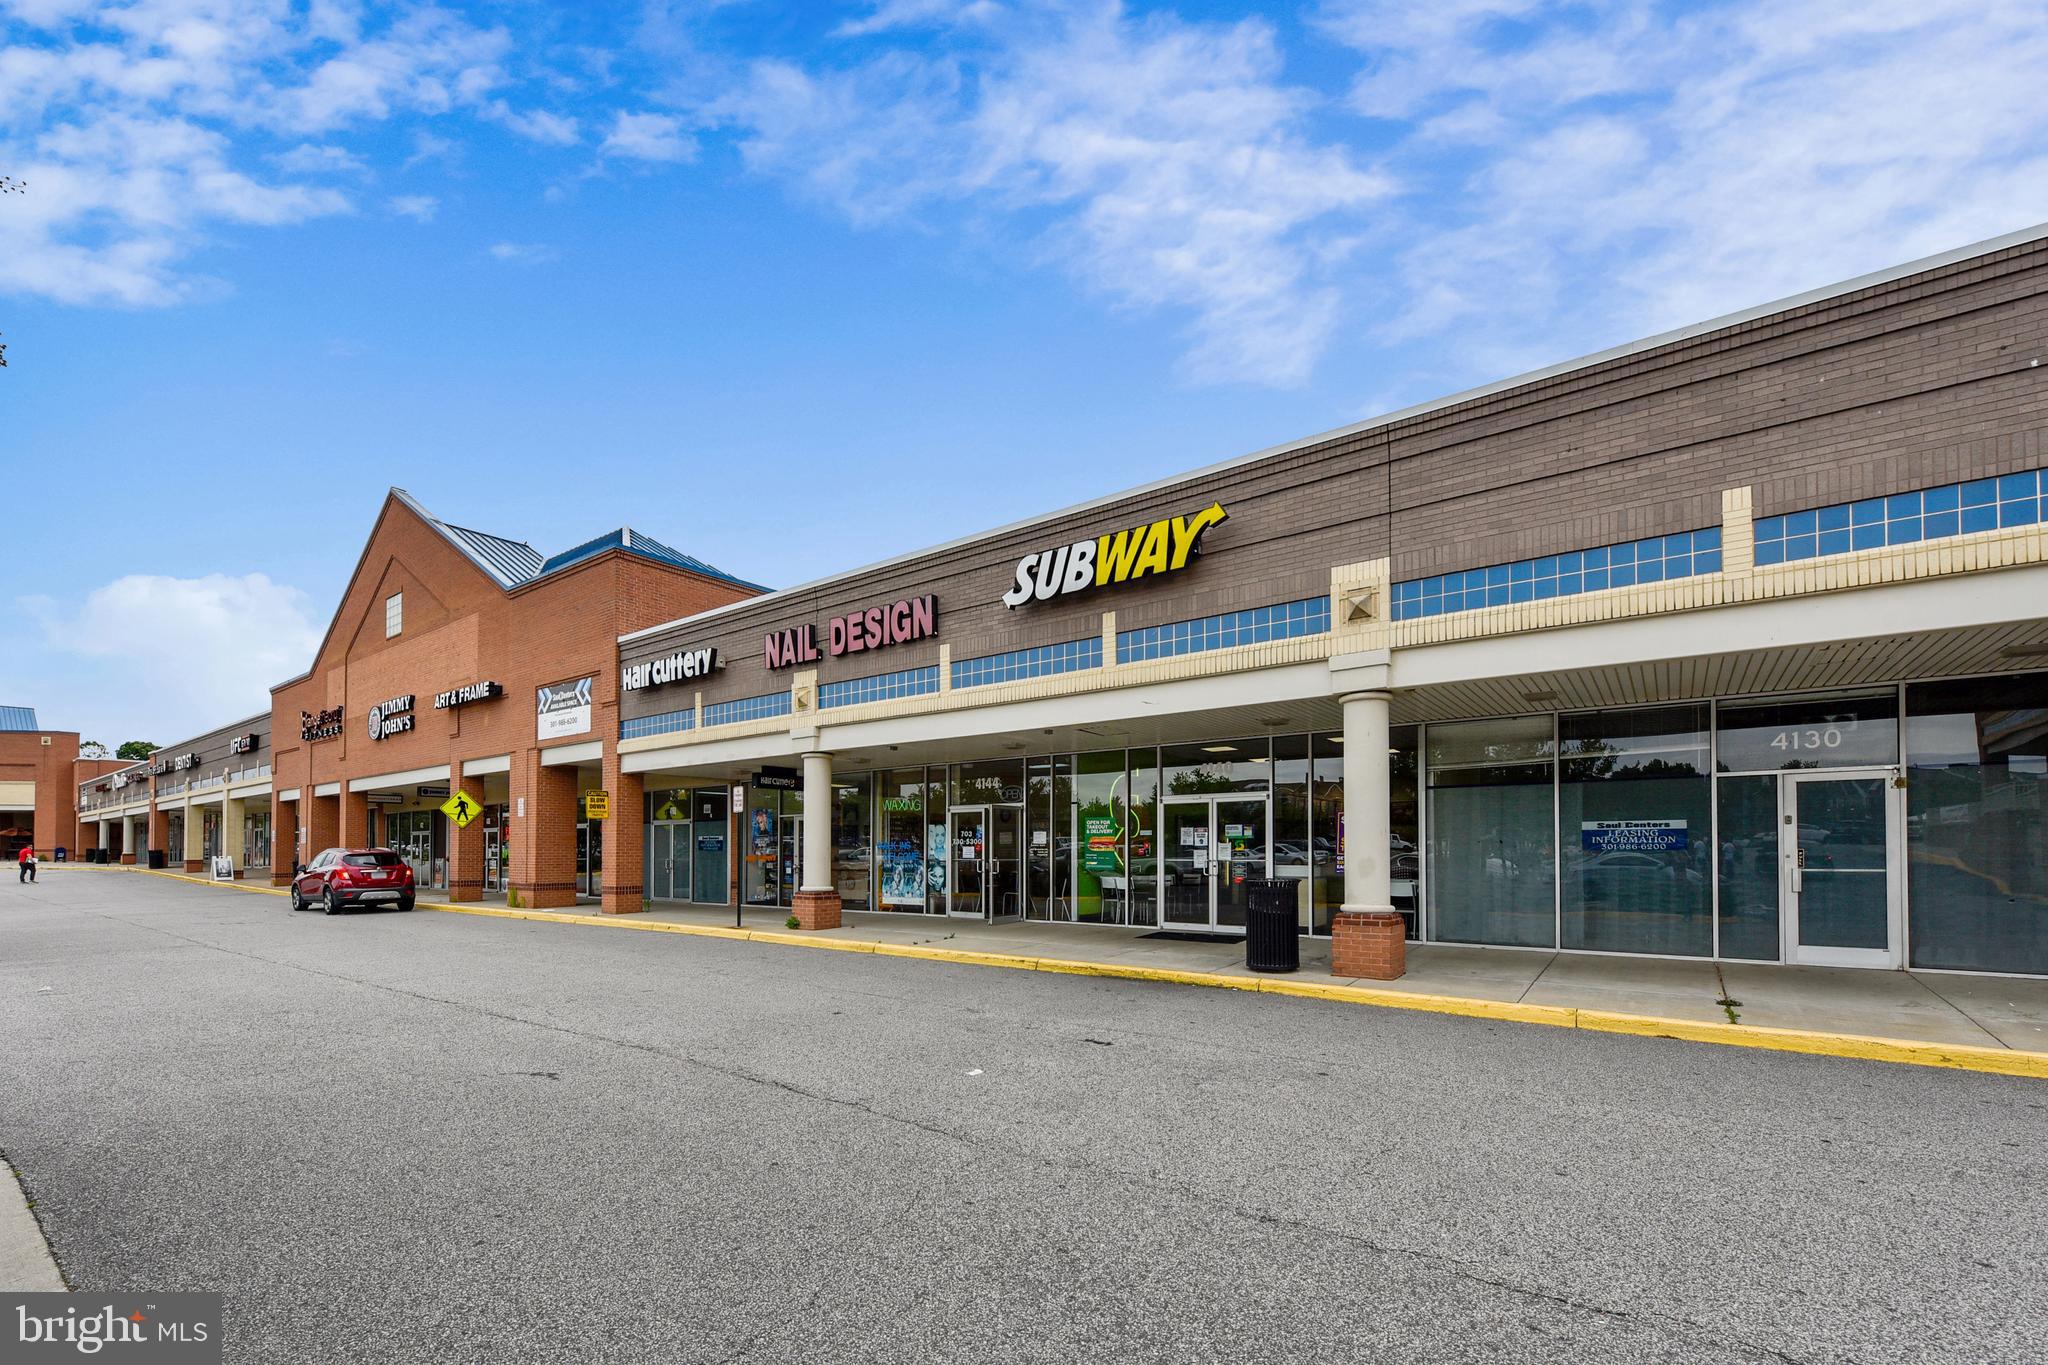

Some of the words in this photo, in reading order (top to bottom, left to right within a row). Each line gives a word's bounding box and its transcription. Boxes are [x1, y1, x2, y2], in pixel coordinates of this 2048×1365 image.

[1002, 501, 1228, 610] SUBWAY
[764, 623, 818, 670] NAIL
[829, 593, 934, 657] DESIGN
[622, 662, 651, 691] Hair
[433, 693, 450, 709] ART
[450, 692, 457, 705] &
[458, 681, 490, 703] FRAME
[381, 695, 411, 719] JIMMY
[381, 715, 411, 739] JOHN'S
[1770, 729, 1842, 750] 4130
[174, 753, 192, 771] DENTIST
[975, 777, 1001, 790] 4144
[883, 799, 921, 812] WAXING
[960, 830, 973, 838] 703
[1608, 829, 1659, 838] LEASING
[1625, 821, 1671, 829] Centers
[1592, 835, 1677, 844] INFORMATION
[1601, 843, 1667, 851] 301-986-6200
